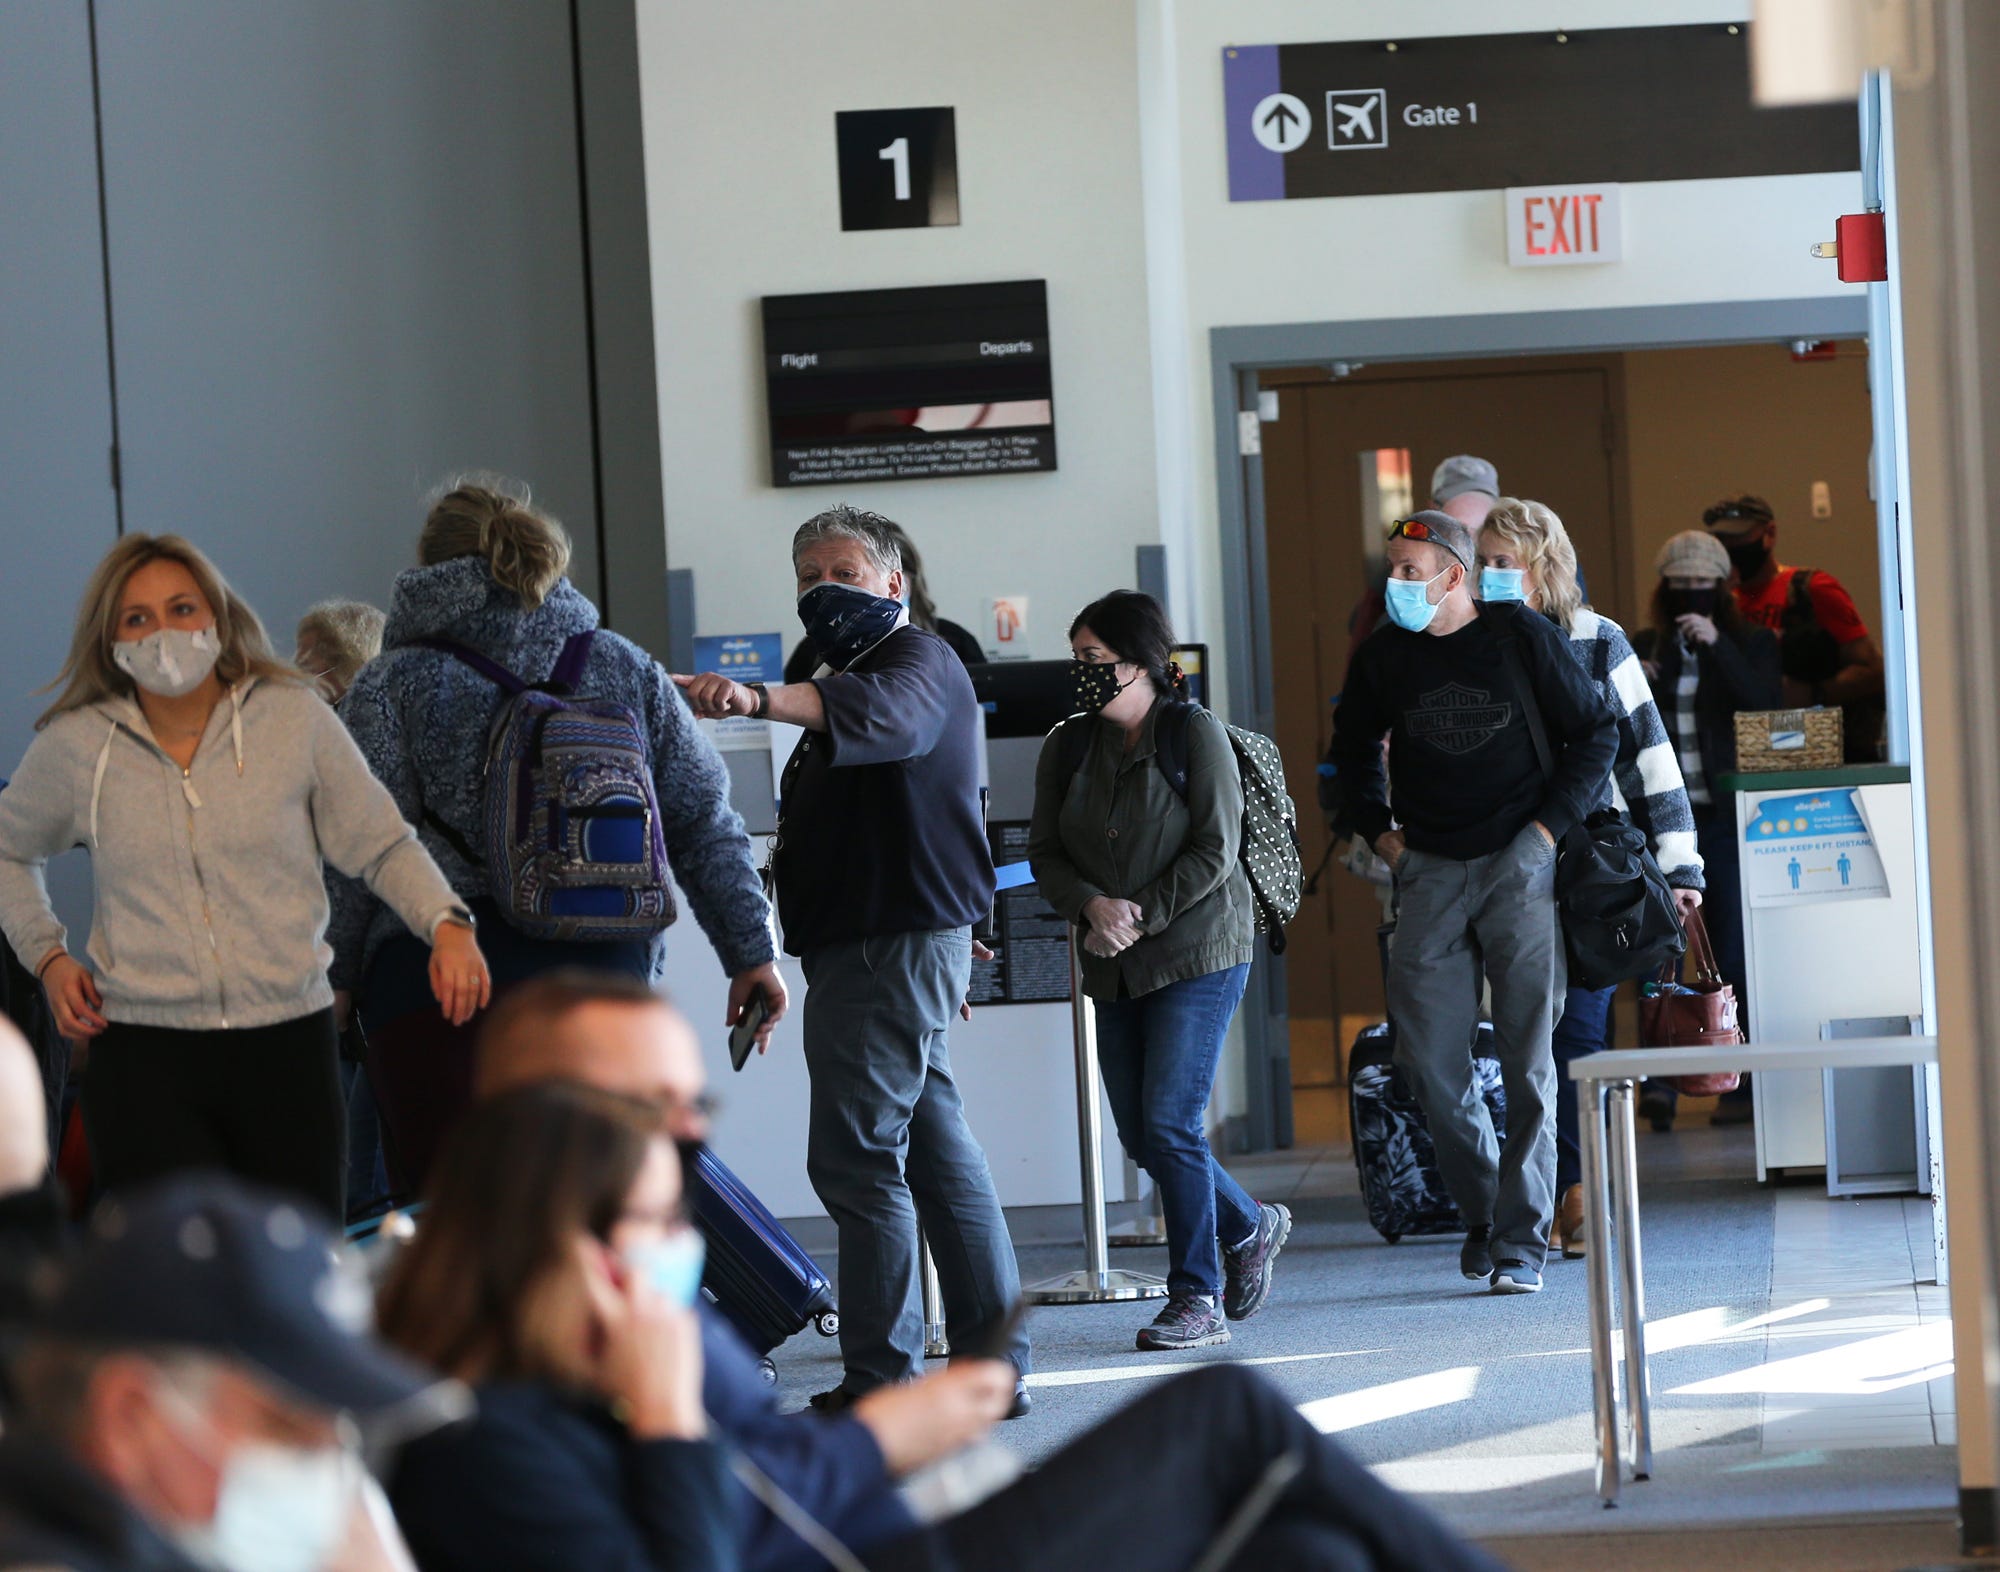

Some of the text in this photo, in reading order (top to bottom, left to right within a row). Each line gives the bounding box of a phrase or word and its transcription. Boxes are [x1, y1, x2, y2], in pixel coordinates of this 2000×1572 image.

[1403, 102, 1477, 126] Gate 1
[879, 137, 911, 200] 1
[1524, 194, 1603, 256] EXIT
[979, 341, 1033, 356] Departs
[781, 353, 818, 369] Flight
[788, 450, 808, 459] New
[831, 446, 877, 458] Regulation
[948, 439, 988, 450] Baggage
[806, 459, 829, 469] Must
[830, 458, 843, 468] Be
[867, 456, 887, 466] Size
[889, 455, 900, 464] To
[914, 452, 942, 462] Under
[944, 451, 964, 461] Your
[966, 449, 987, 459] Seat
[1012, 447, 1031, 456] The
[788, 470, 832, 481] Overhead
[962, 461, 983, 471] Must
[1430, 692, 1480, 707] MOTOR
[1409, 709, 1504, 729] HARLEY-DAVIDSON
[1794, 799, 1831, 811] allegiant
[1754, 846, 1787, 855] PLEASE
[1790, 843, 1813, 852] KEEP
[1836, 838, 1873, 849] DISTANC
